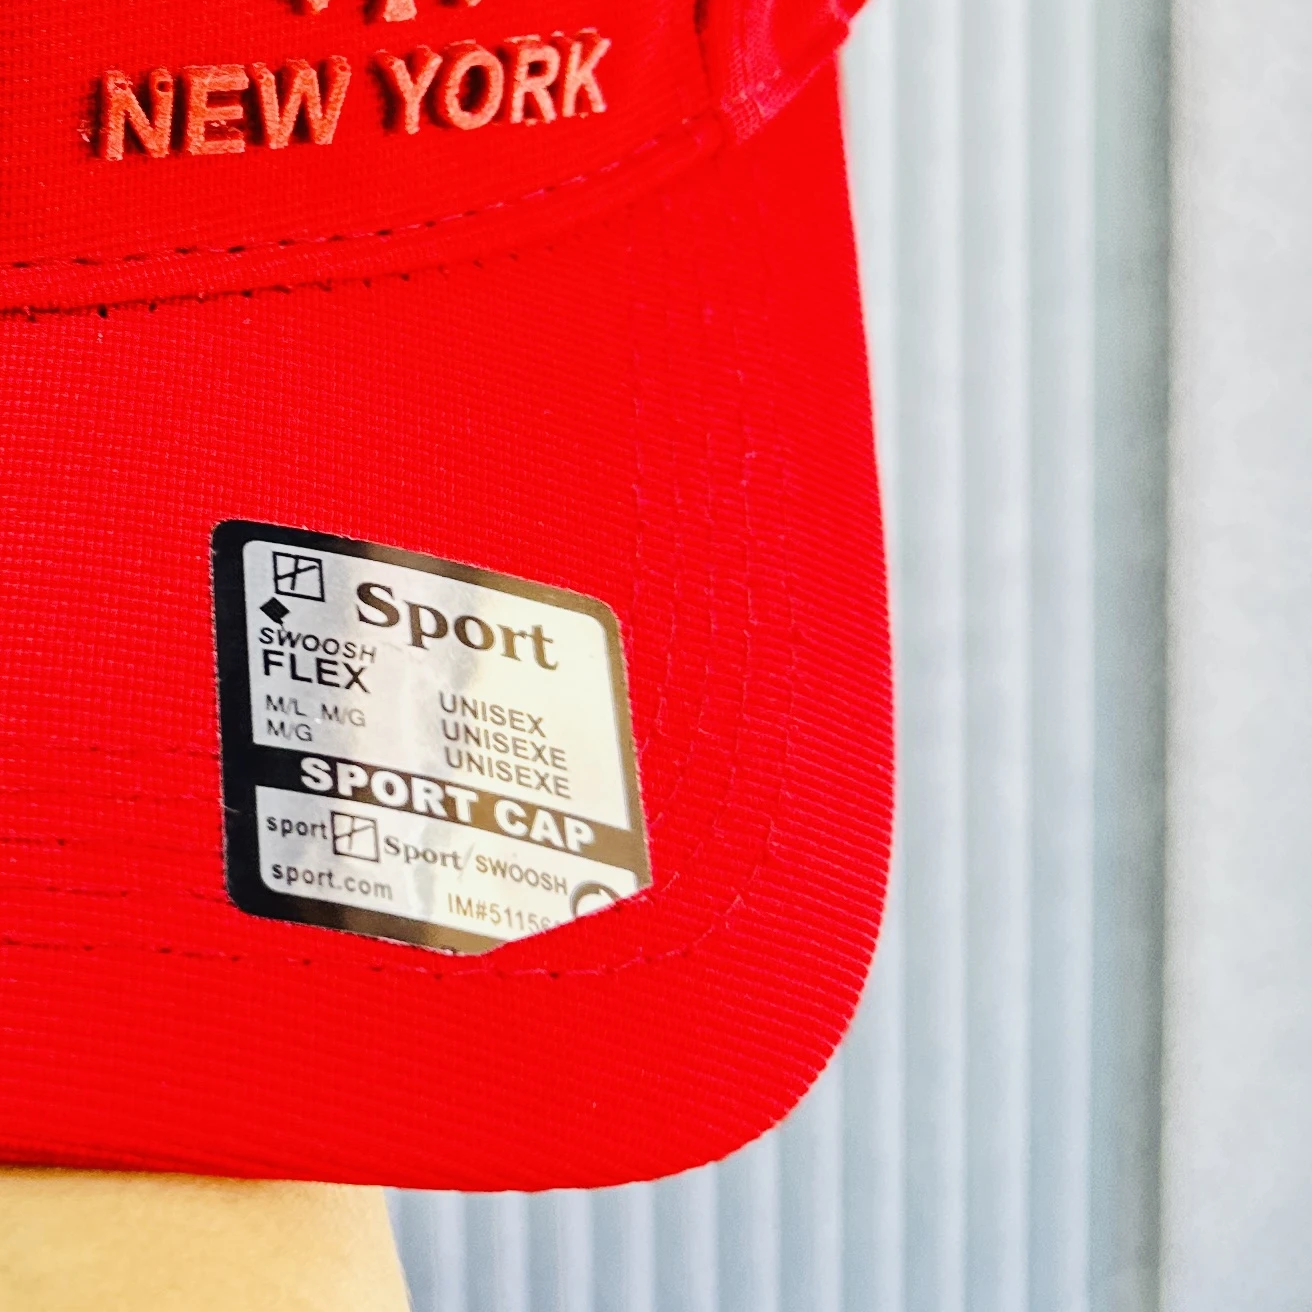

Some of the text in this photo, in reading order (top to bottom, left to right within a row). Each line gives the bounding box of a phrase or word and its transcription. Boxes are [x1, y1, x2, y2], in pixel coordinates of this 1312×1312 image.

[100, 28, 611, 161] NEW YORK
[258, 627, 378, 664] SWOOSH
[356, 582, 559, 671] Sport
[262, 649, 371, 694] FLEX
[438, 691, 547, 739] UNISEX
[441, 719, 569, 772] UNISEXE
[444, 747, 572, 800] UNISEXE
[266, 815, 328, 840] sport
[300, 756, 596, 856] SPORT CAP
[272, 862, 394, 901] sport.com
